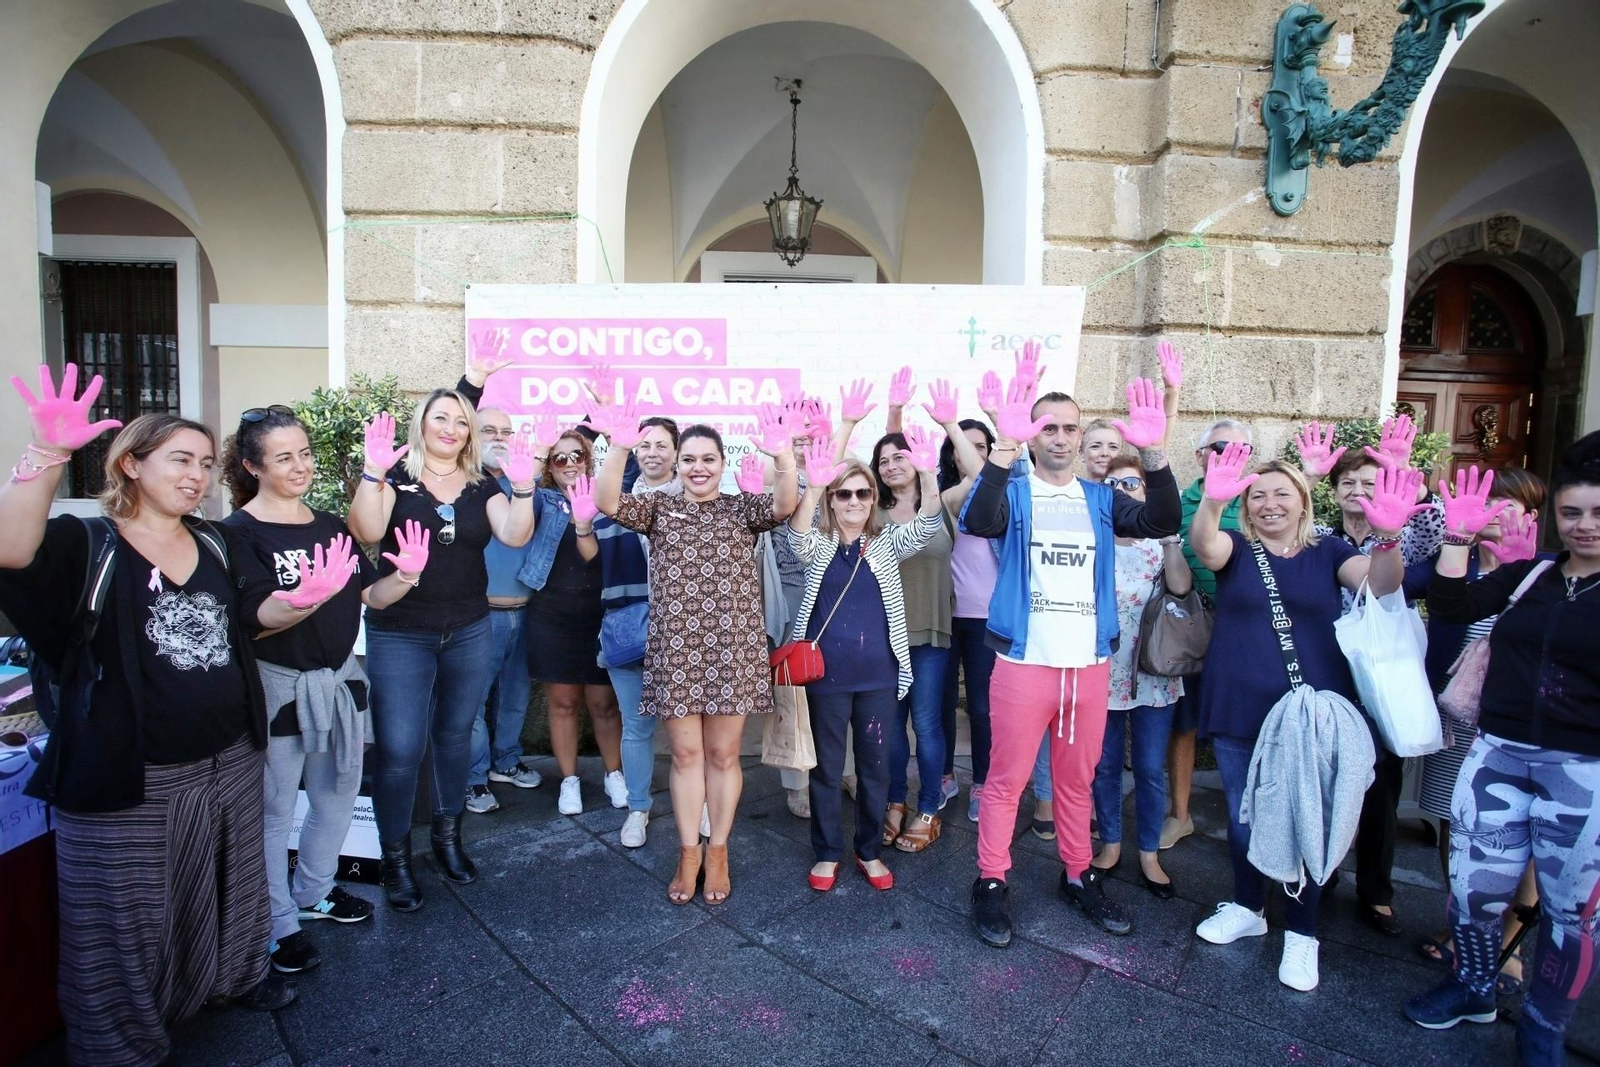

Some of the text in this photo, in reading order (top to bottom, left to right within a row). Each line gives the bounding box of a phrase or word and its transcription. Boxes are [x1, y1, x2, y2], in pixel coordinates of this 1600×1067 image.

[520, 326, 714, 361] CONTIGO,
[671, 376, 782, 406] CARA
[728, 422, 763, 436] MA
[1041, 550, 1087, 568] NEW
[1254, 553, 1280, 597] FASHION
[1030, 598, 1051, 607] RACK
[1270, 599, 1290, 629] BEST
[1278, 632, 1294, 651] MY
